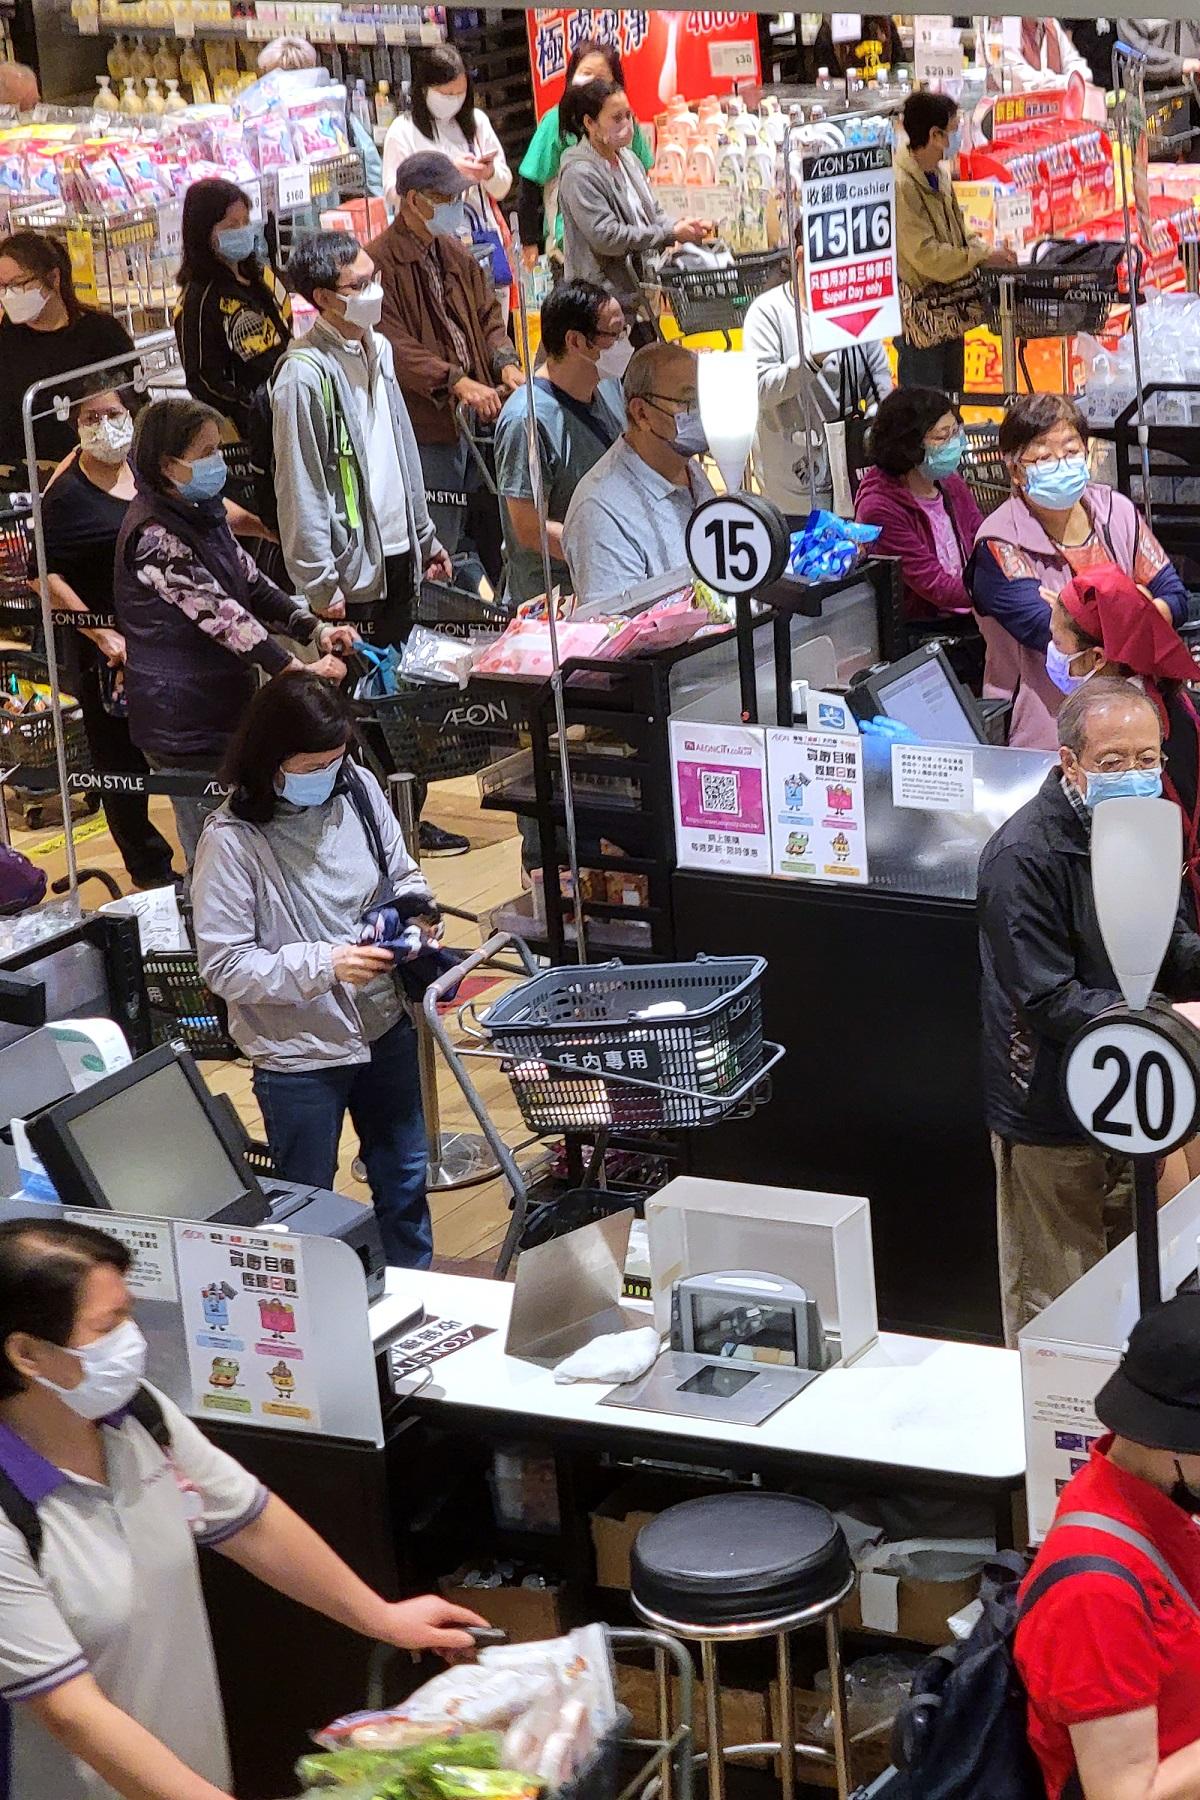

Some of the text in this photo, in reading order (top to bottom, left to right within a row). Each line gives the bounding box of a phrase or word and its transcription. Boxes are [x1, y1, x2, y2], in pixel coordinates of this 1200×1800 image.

[846, 149, 885, 172] STYLE
[849, 182, 891, 199] Cashier
[809, 205, 891, 258] 15 16
[822, 281, 883, 306] Super Day only
[437, 490, 468, 506] STYLE
[704, 518, 758, 582] 15
[77, 612, 116, 627] STYLE
[103, 775, 145, 792] STYLE
[559, 1049, 649, 1073] 店內專用
[1092, 1044, 1175, 1141] 20
